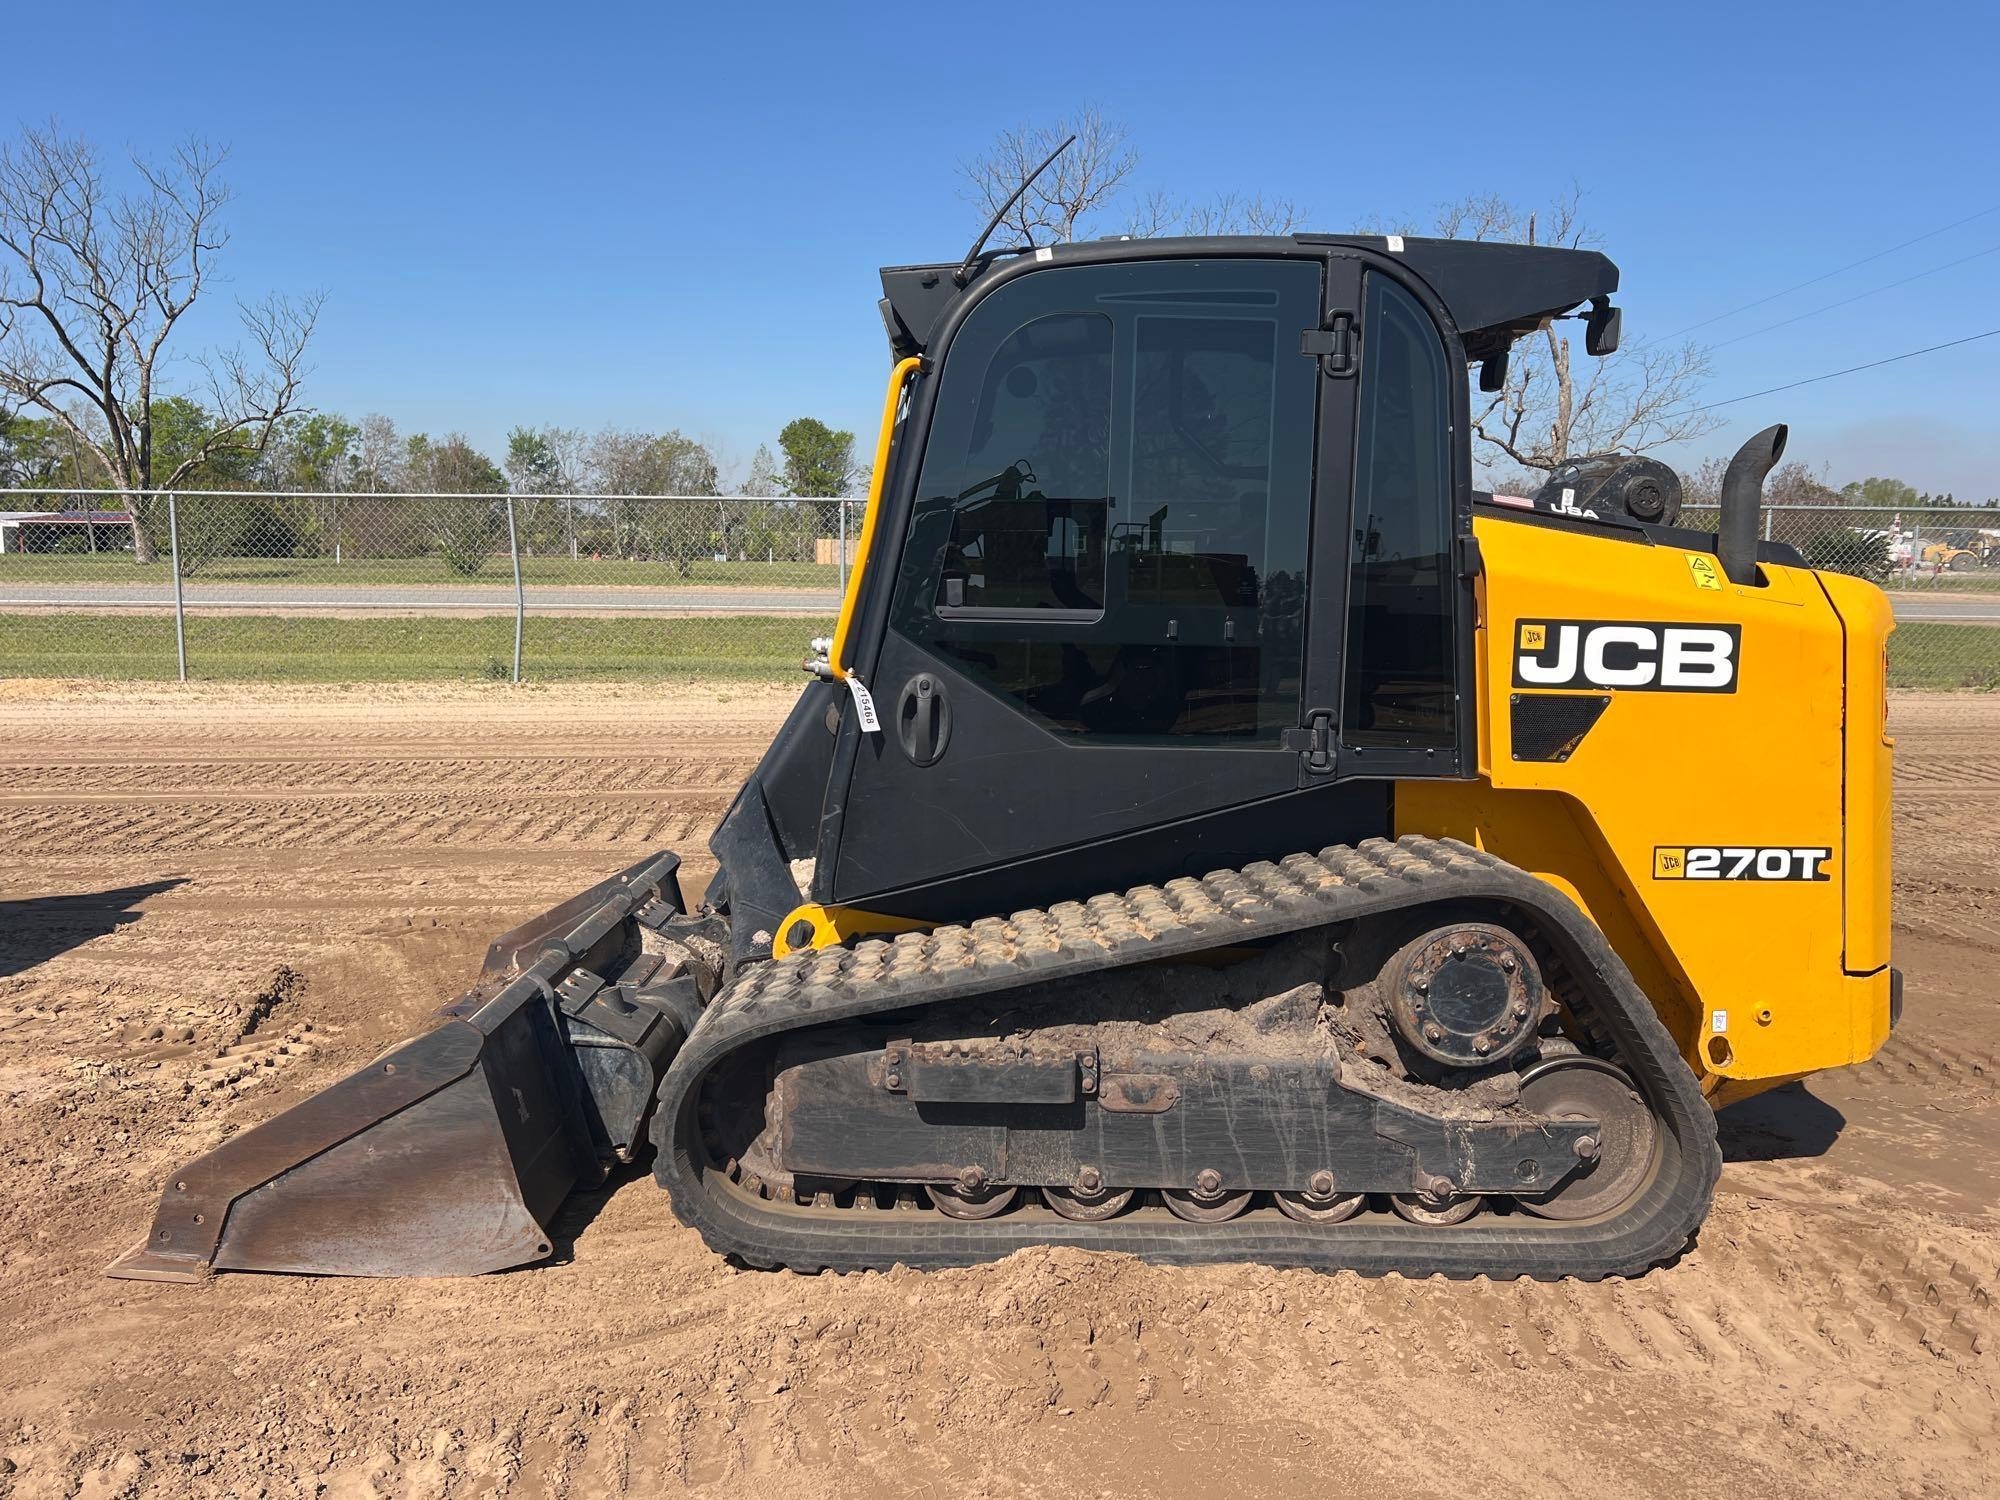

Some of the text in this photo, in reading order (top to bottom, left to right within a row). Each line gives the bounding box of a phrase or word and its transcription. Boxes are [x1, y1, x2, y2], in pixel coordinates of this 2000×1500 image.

[1551, 503, 1600, 520] USA
[1527, 630, 1542, 643] JCB
[1519, 625, 1733, 687] JCB
[858, 687, 874, 724] 215468
[1664, 856, 1680, 870] JCB
[1687, 848, 1826, 879] 270T
